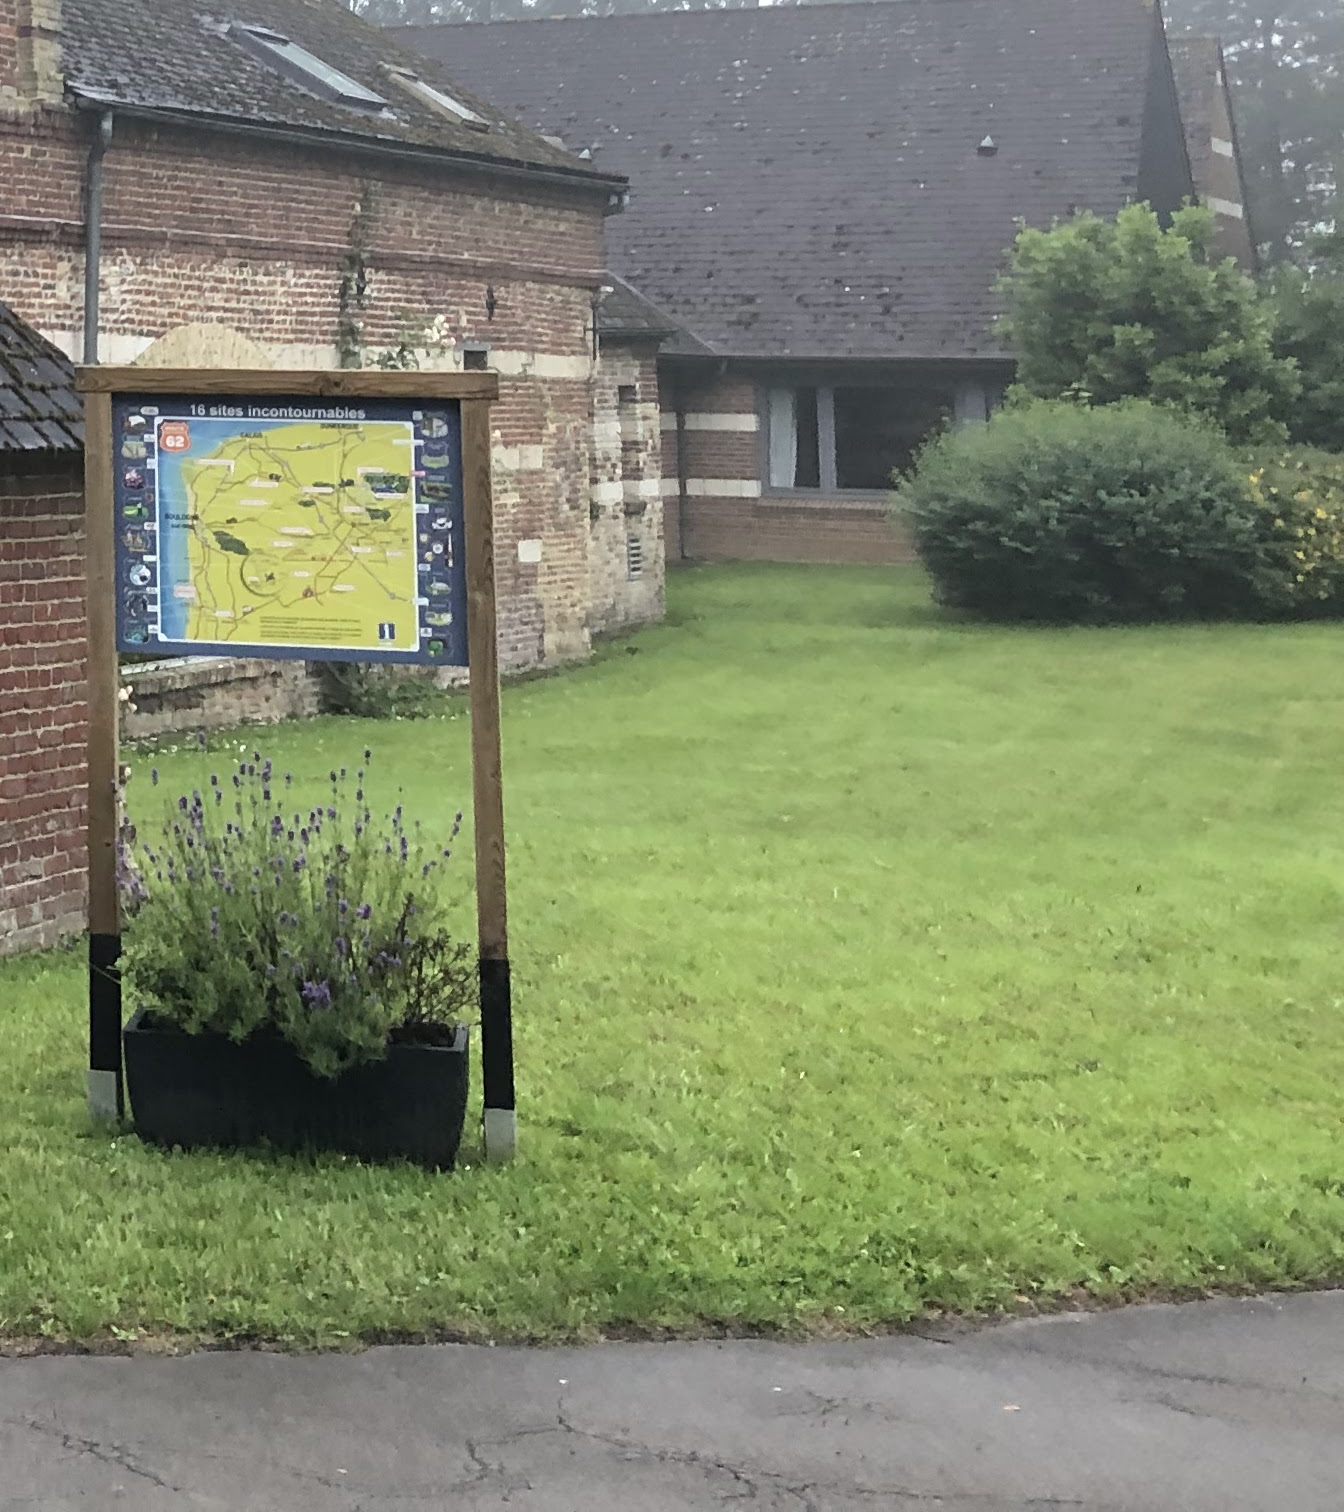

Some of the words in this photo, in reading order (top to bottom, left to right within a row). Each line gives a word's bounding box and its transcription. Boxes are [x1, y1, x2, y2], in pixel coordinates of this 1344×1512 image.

[190, 404, 206, 416] 16
[209, 405, 244, 417] sites
[247, 405, 366, 419] incontournables
[165, 435, 185, 448] 62
